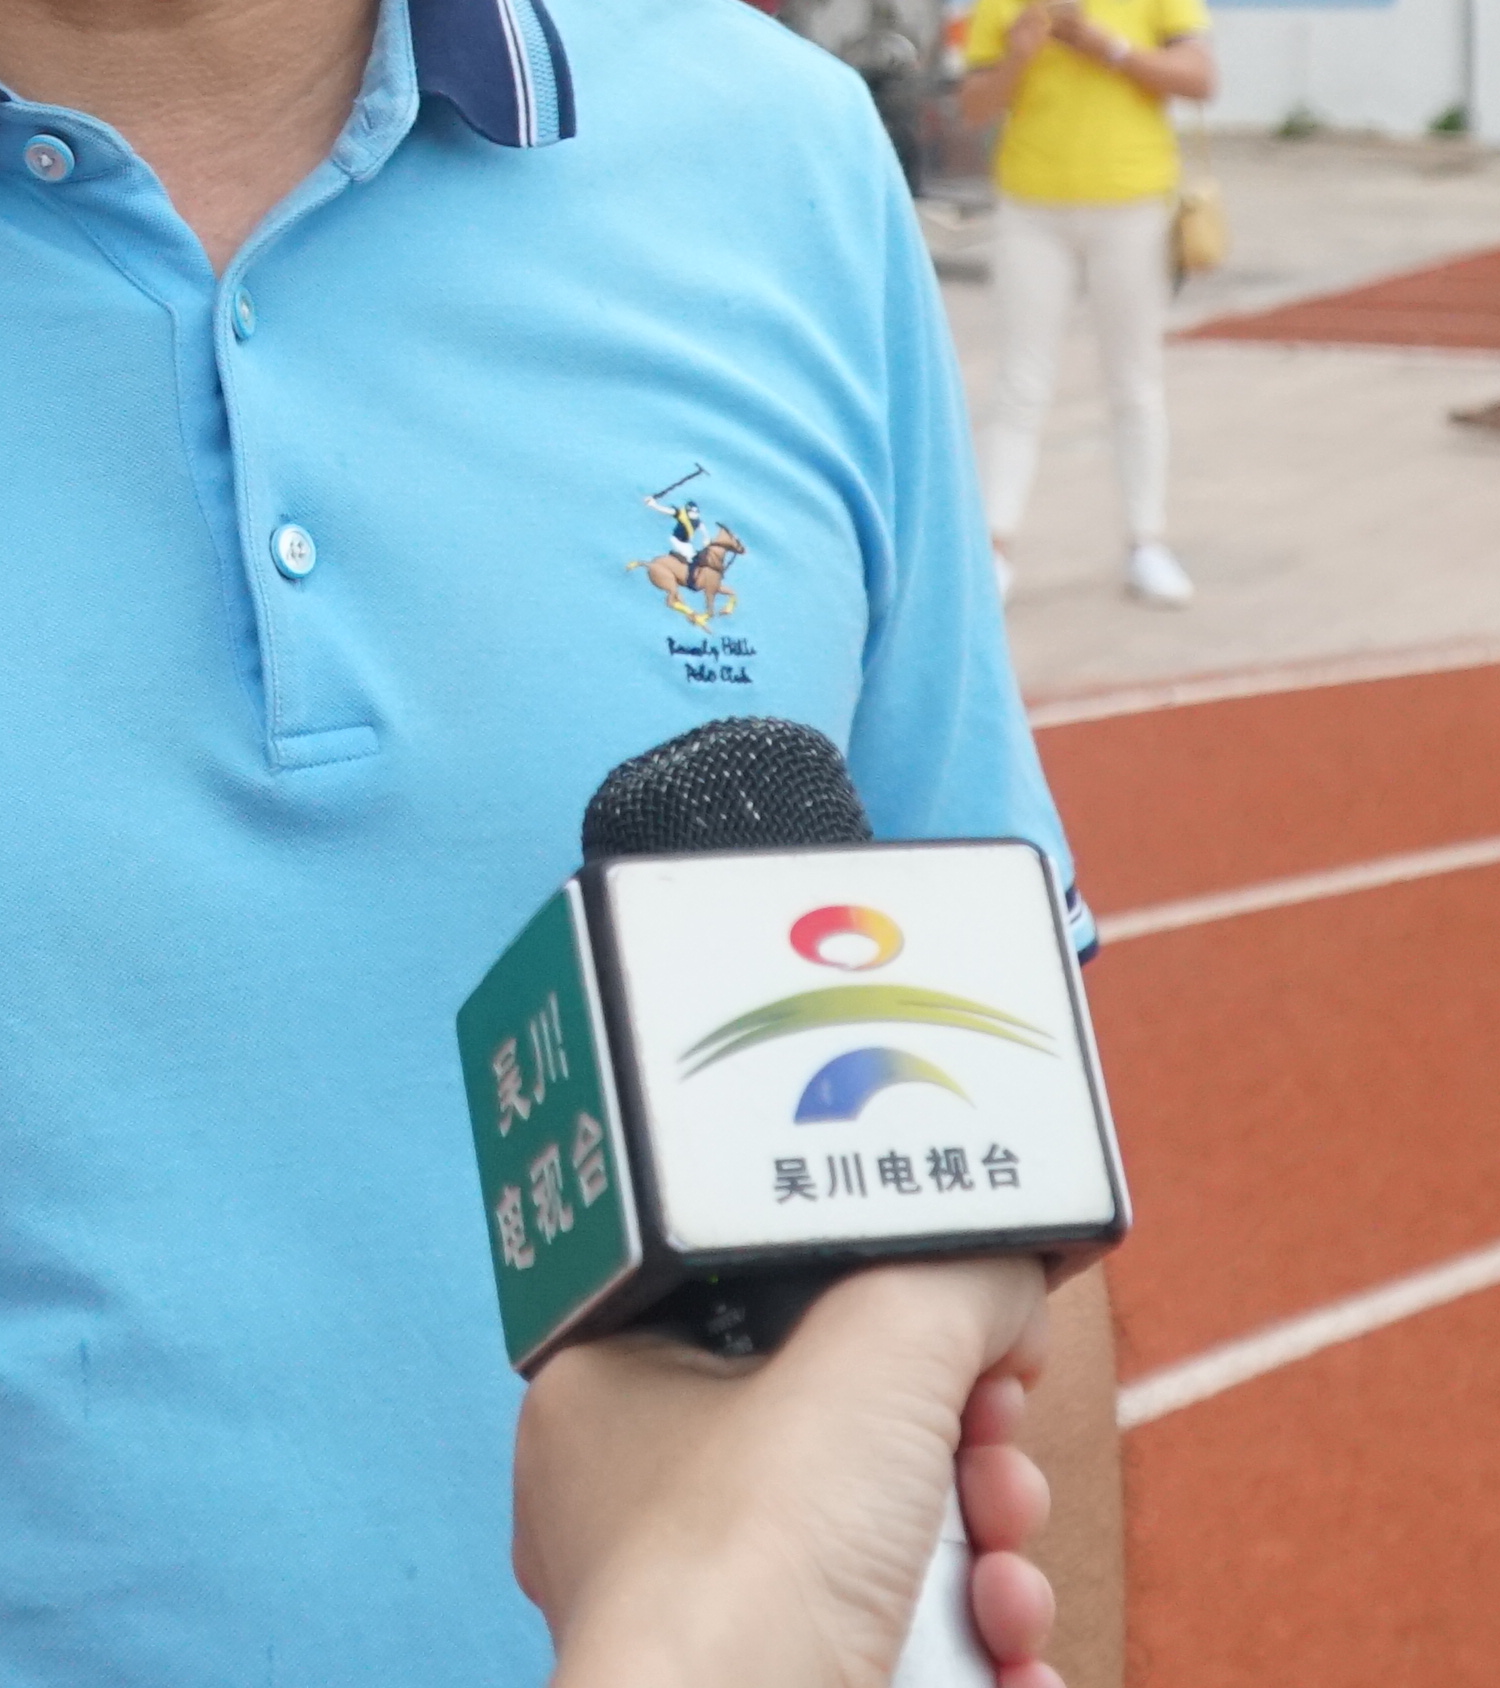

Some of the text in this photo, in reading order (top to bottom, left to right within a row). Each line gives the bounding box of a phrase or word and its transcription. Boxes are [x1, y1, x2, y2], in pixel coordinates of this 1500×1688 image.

[491, 992, 570, 1137] 吴川
[495, 1113, 608, 1270] 电视台
[772, 1143, 1022, 1203] 吴川电视台
